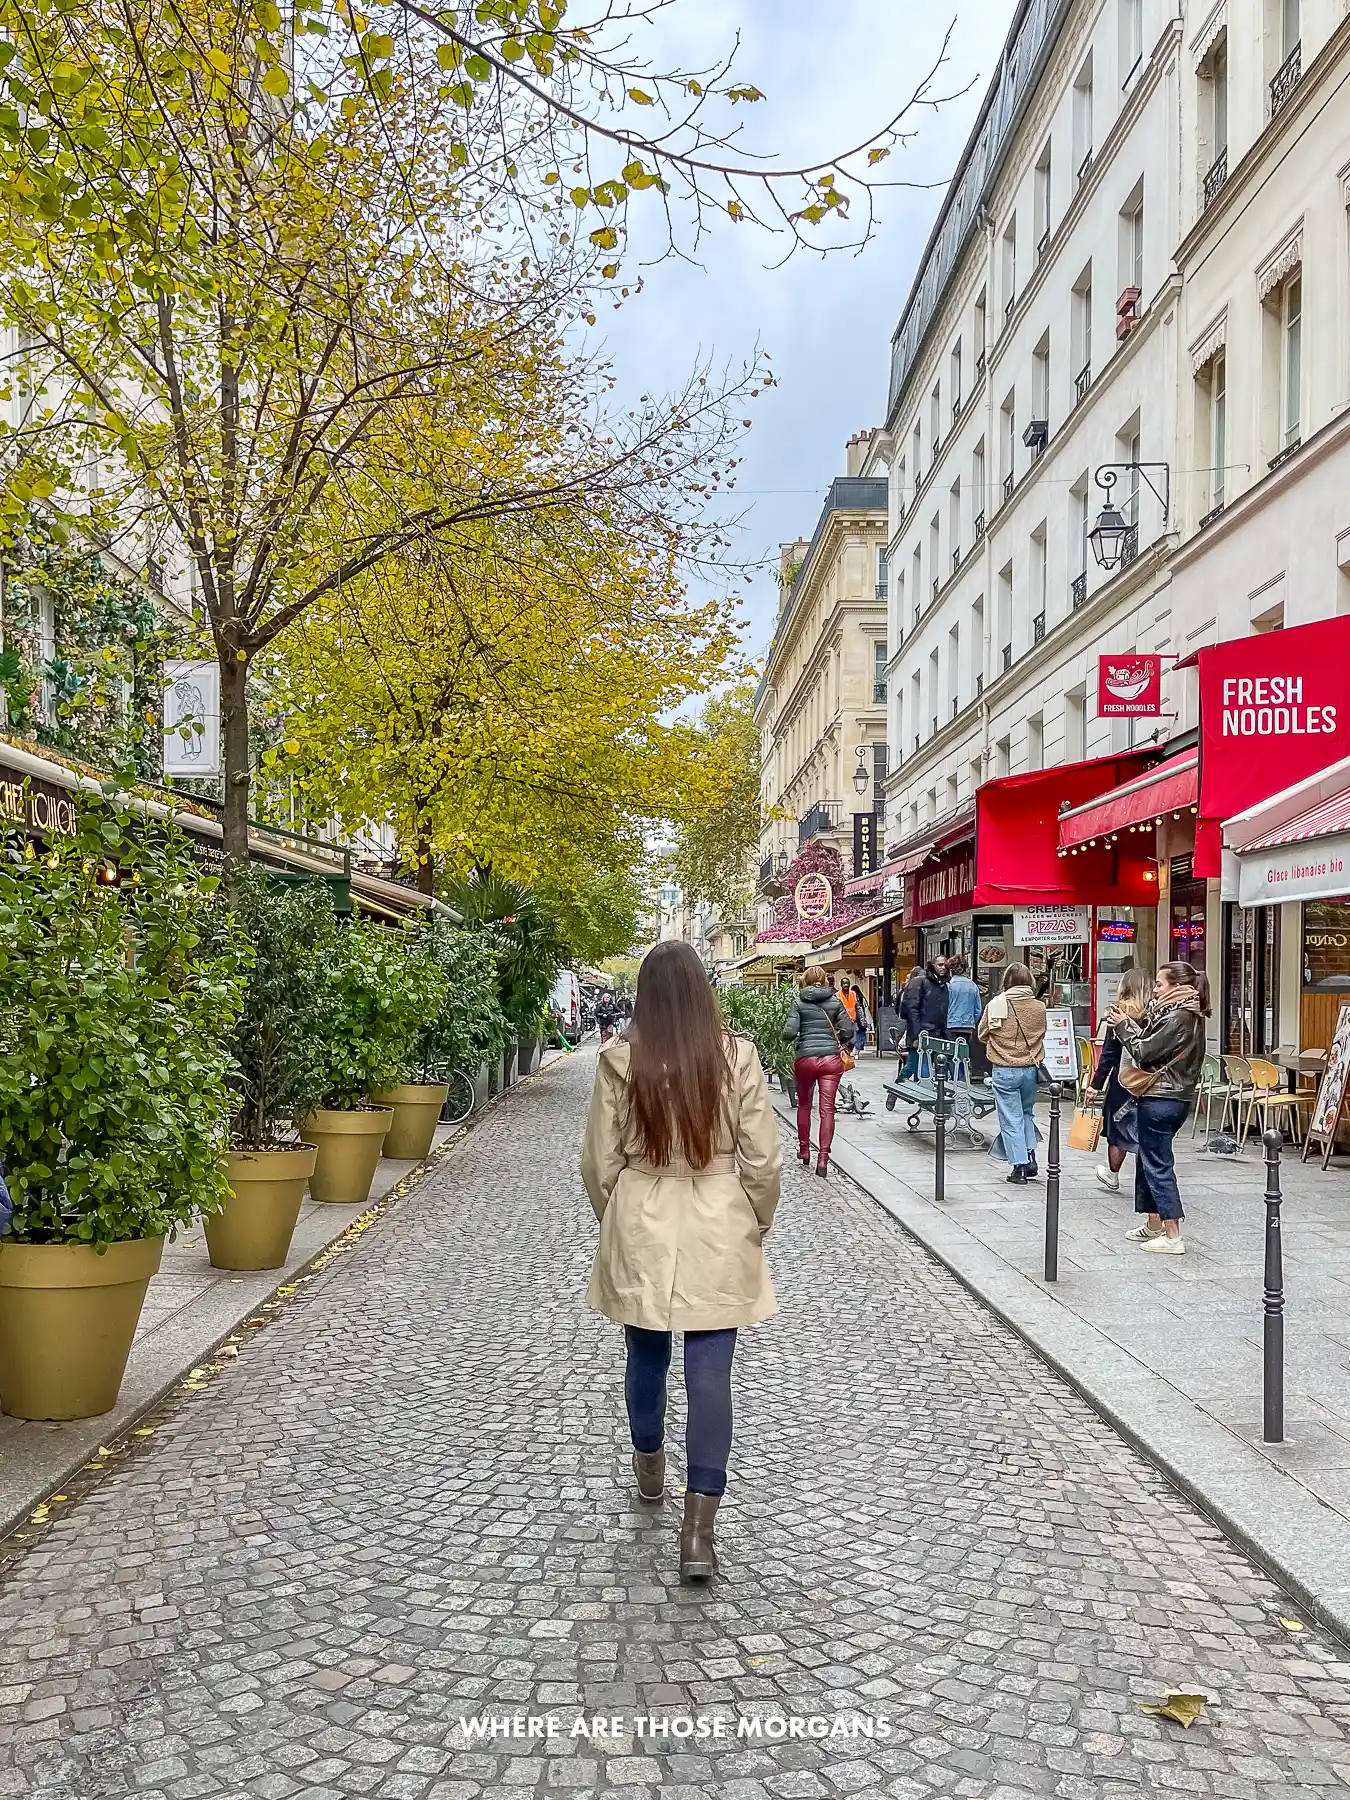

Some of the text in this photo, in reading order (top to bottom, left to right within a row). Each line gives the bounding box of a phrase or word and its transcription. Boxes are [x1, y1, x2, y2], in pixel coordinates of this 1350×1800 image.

[1223, 676, 1303, 706] FRESH
[1103, 703, 1156, 713] FRESH NOODLES
[1222, 706, 1337, 737] NOODLES
[1267, 858, 1344, 883] Glace libanaise bio
[1028, 919, 1077, 934] PIZZAS
